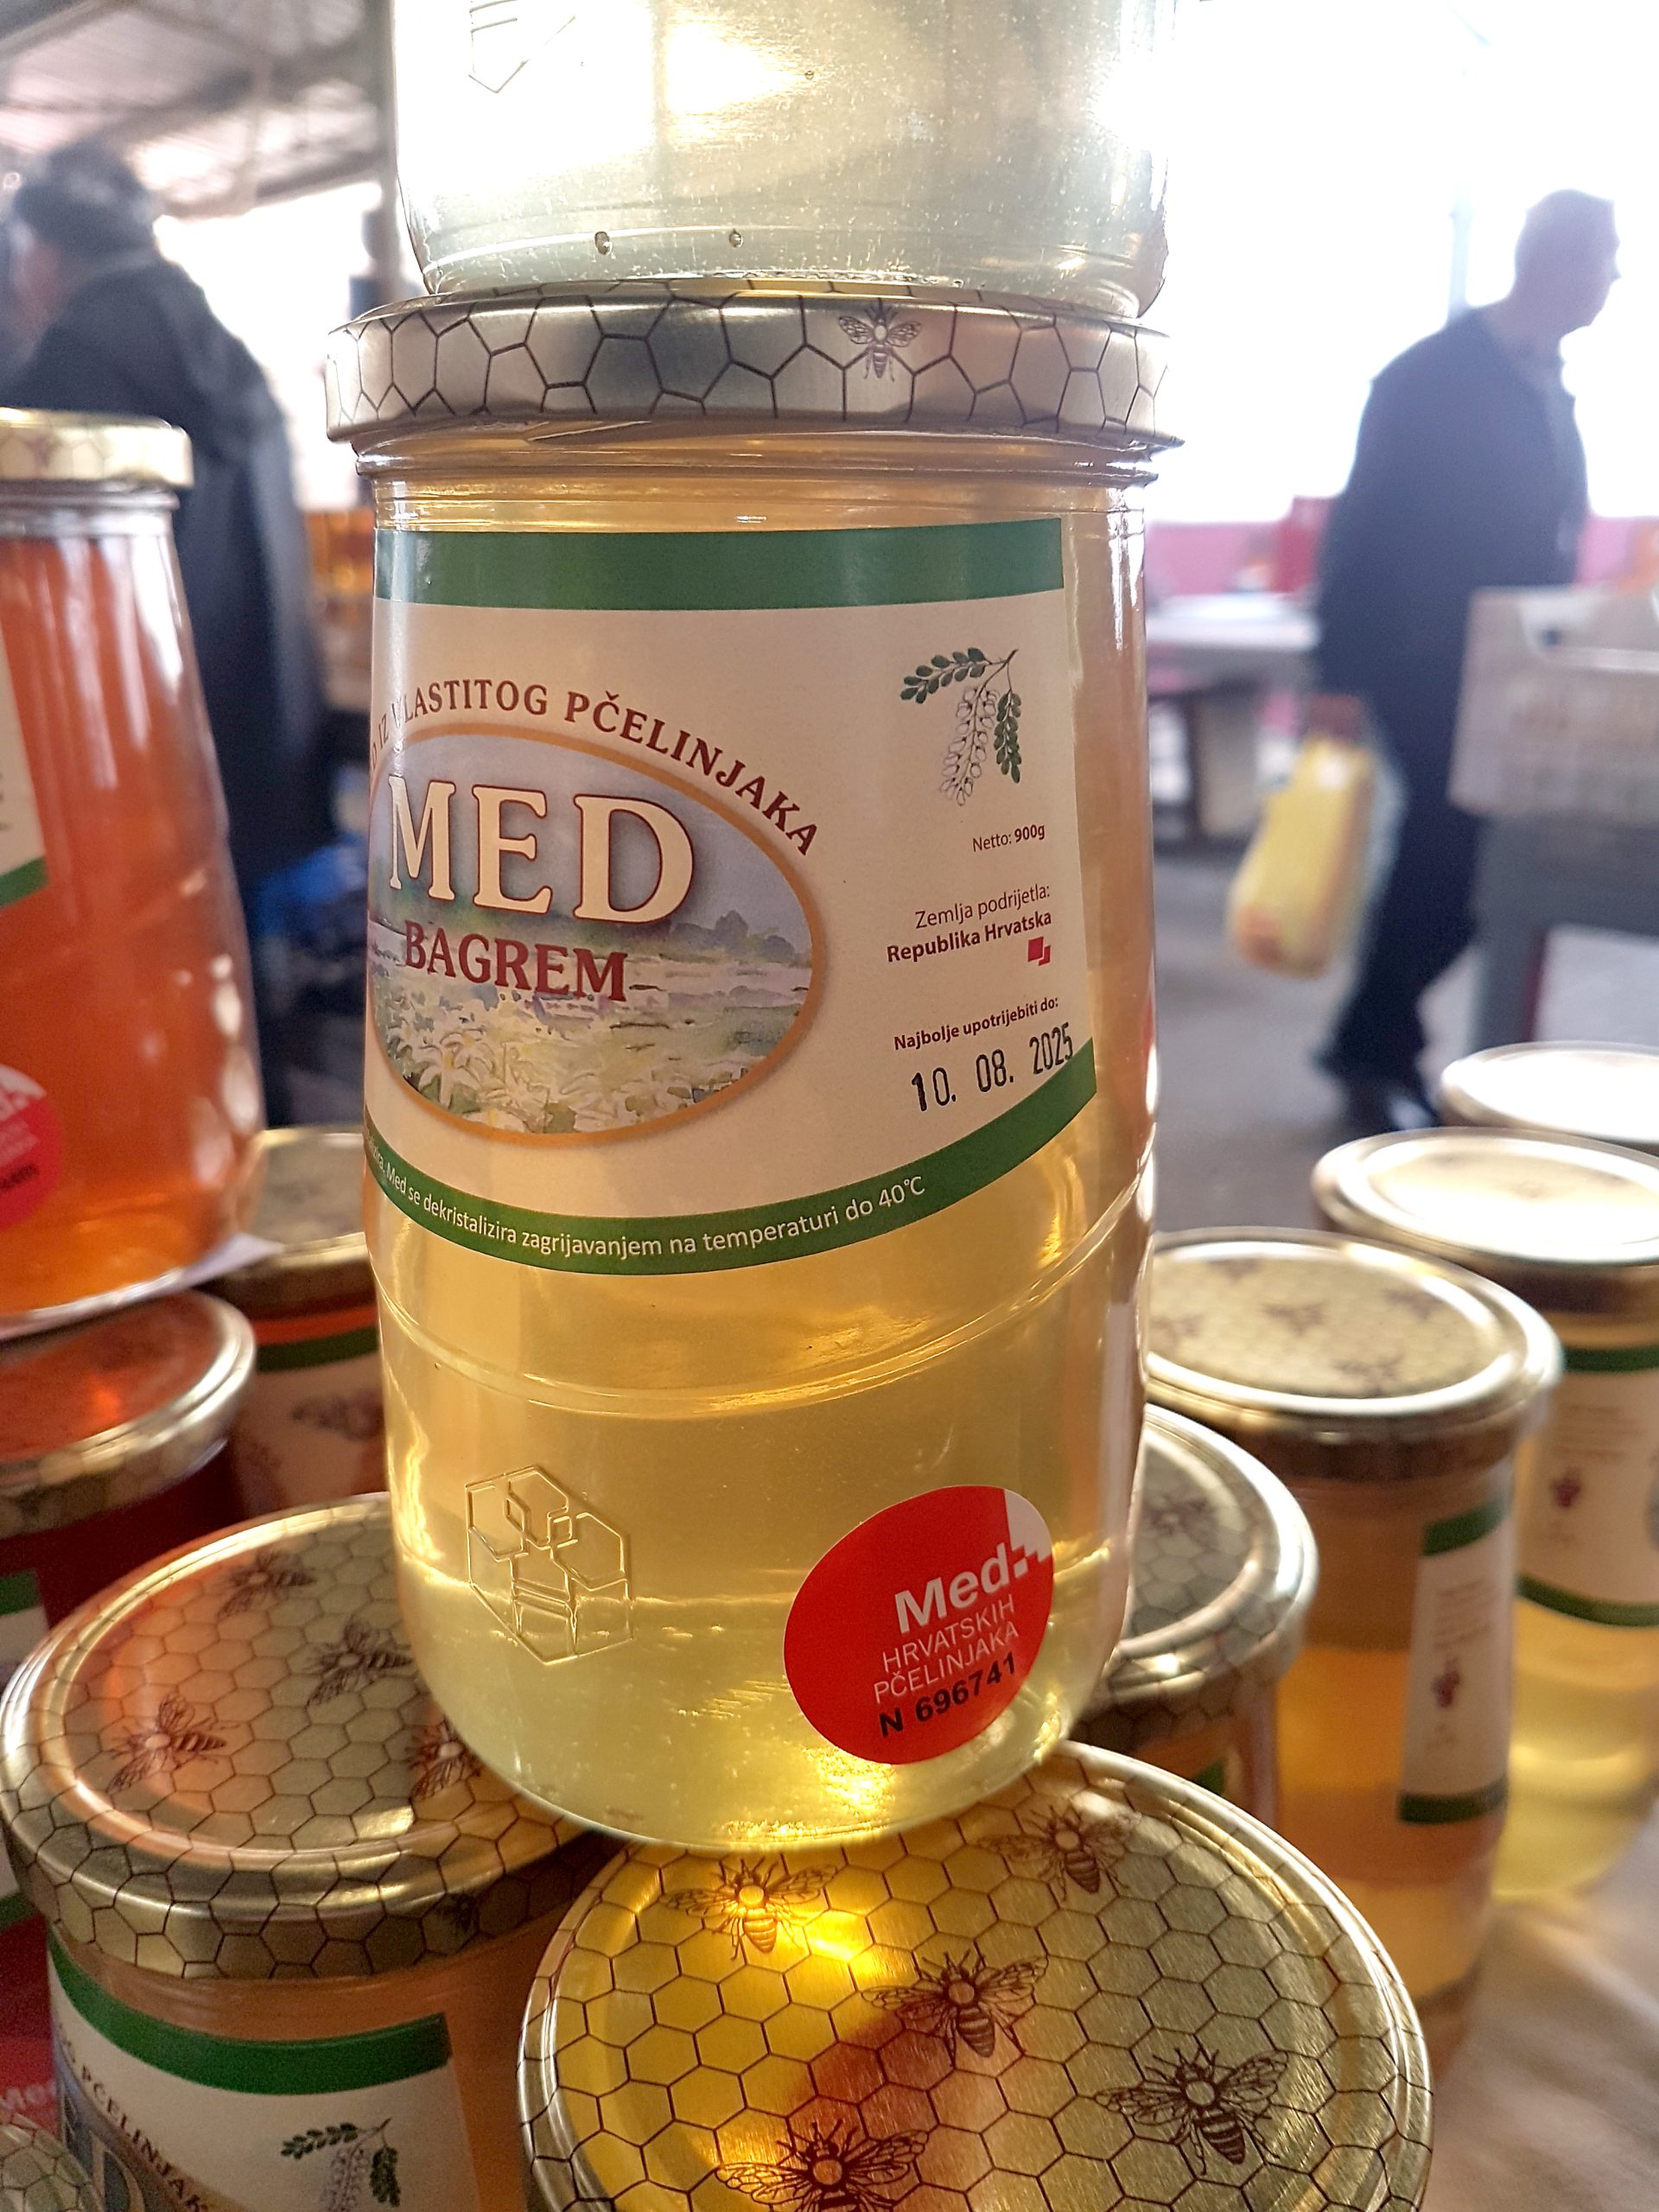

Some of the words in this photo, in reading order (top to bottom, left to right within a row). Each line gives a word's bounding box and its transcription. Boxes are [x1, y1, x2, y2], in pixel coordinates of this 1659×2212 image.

[564, 690, 819, 855] PČELINJAKA
[388, 774, 695, 926] MED
[972, 831, 1013, 852] Netto:
[1014, 824, 1046, 842] 900g
[887, 929, 981, 963] Republika
[984, 911, 1052, 942] Hrvatska
[915, 903, 973, 929] Zemlja
[978, 883, 1051, 920] podrijetla:
[404, 920, 628, 1002] BAGREM
[893, 1022, 960, 1051] Najbolje
[963, 1000, 1038, 1036] upotrijebiti
[1039, 995, 1058, 1013] do:
[911, 1066, 957, 1112] 10.
[975, 1048, 1014, 1093] 08.
[1029, 1022, 1074, 1075] 2025
[387, 1162, 407, 1195] Med
[408, 1186, 421, 1205] se
[423, 1192, 518, 1244] dekristalizira
[522, 1230, 662, 1262] zagrijavanjem
[670, 1236, 696, 1255] na
[702, 1205, 839, 1252] temperaturi
[845, 1198, 874, 1222] do
[878, 1175, 926, 1209] 40°C
[874, 1621, 1020, 1704] PČELINJAKA
[882, 1593, 1015, 1673] HRVATSKIH
[879, 1707, 905, 1738] N
[915, 1652, 1016, 1722] 696741
